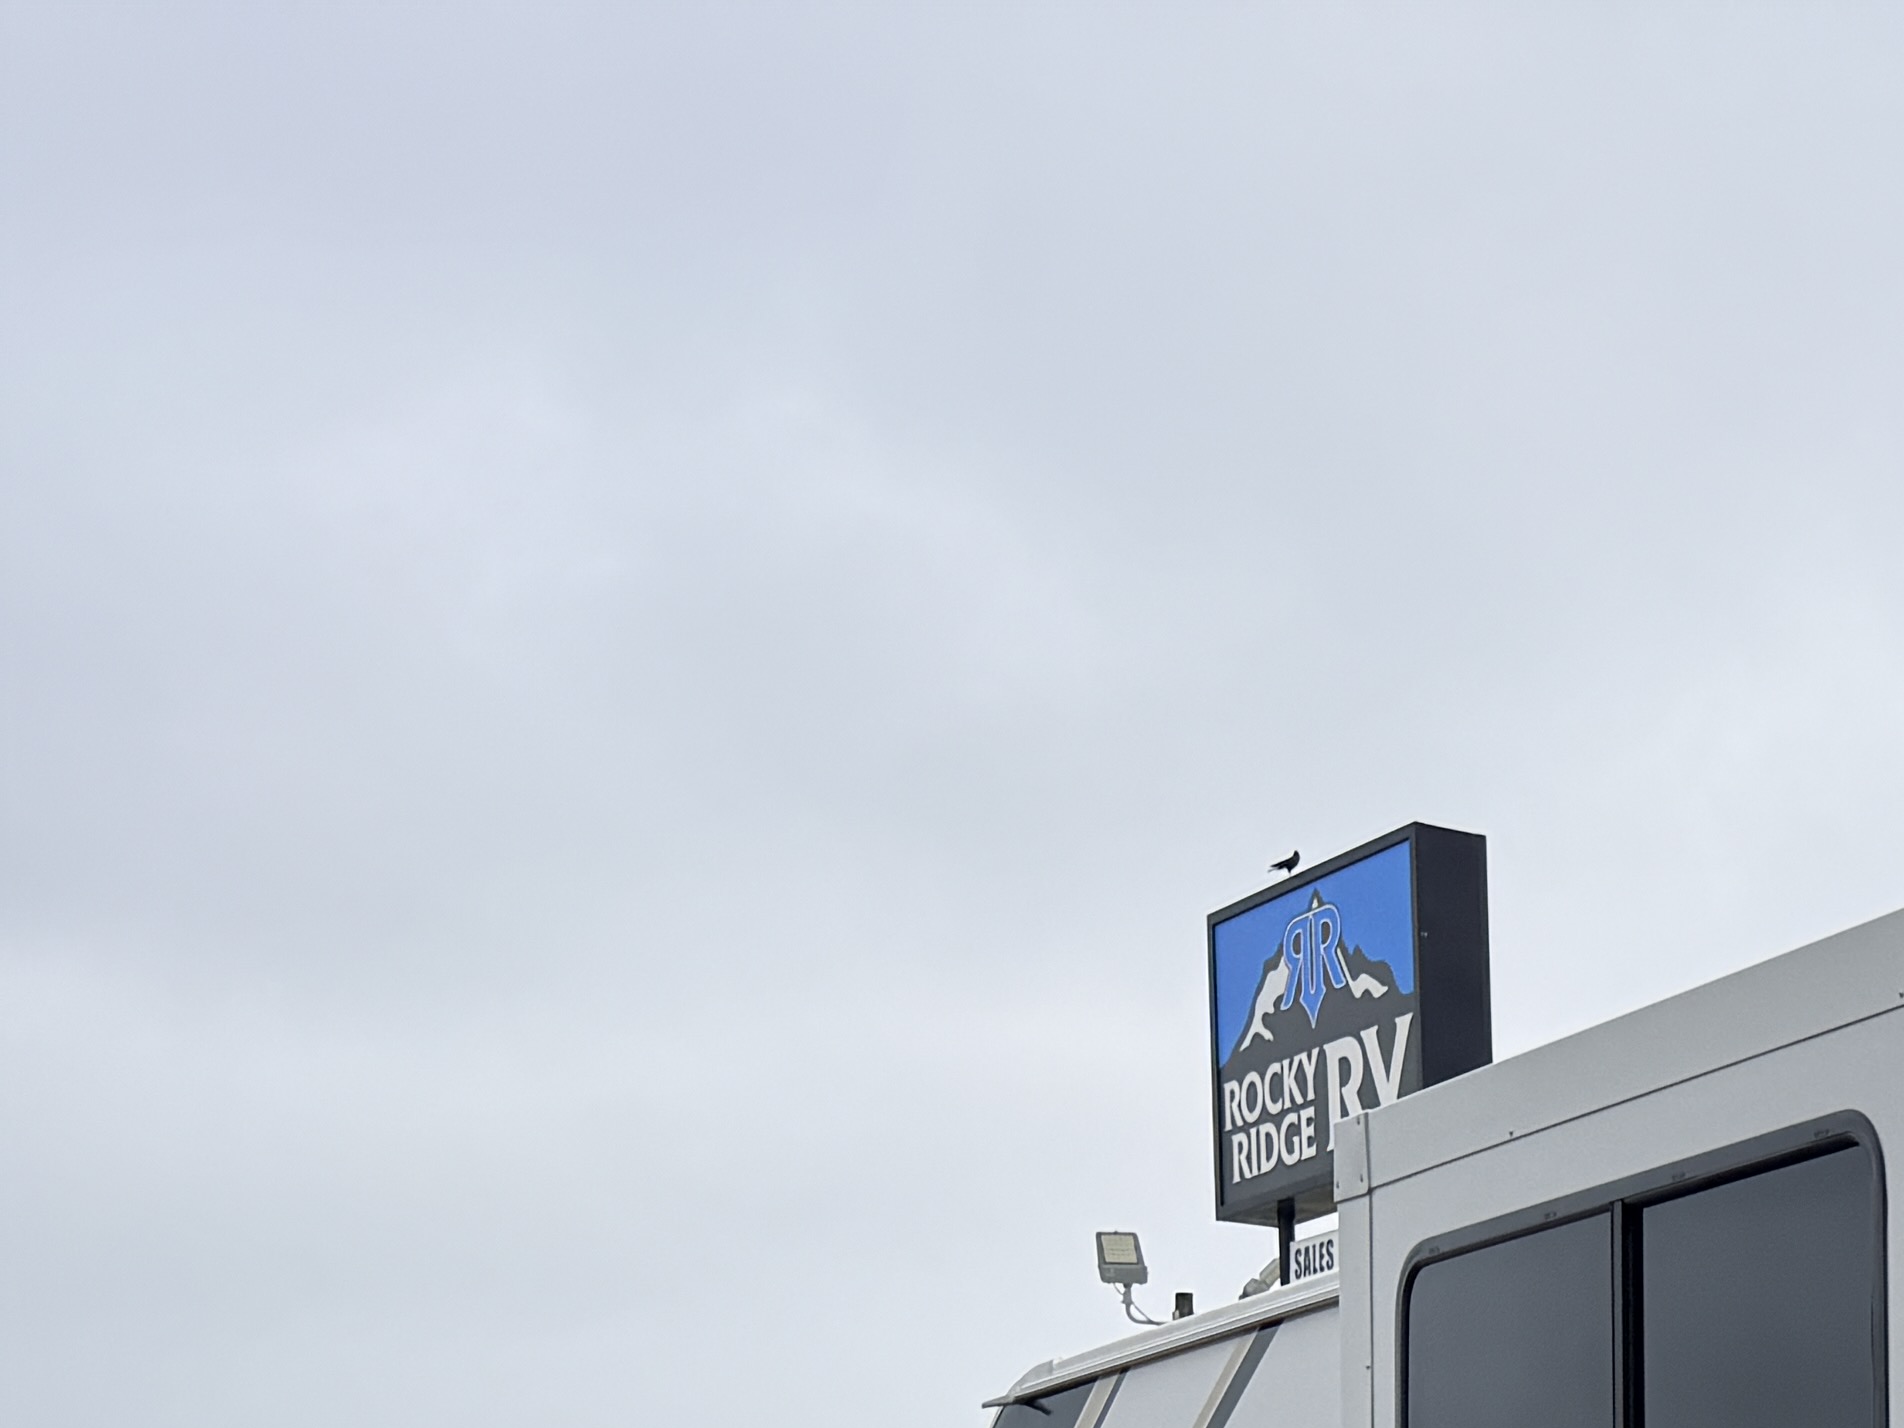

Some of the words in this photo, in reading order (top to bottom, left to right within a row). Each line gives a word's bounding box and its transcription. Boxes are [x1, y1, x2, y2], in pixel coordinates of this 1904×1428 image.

[1224, 1046, 1321, 1132] ROCKY
[1324, 1012, 1414, 1151] RV
[1231, 1106, 1318, 1184] RIDGE
[1294, 1238, 1335, 1280] SALES
